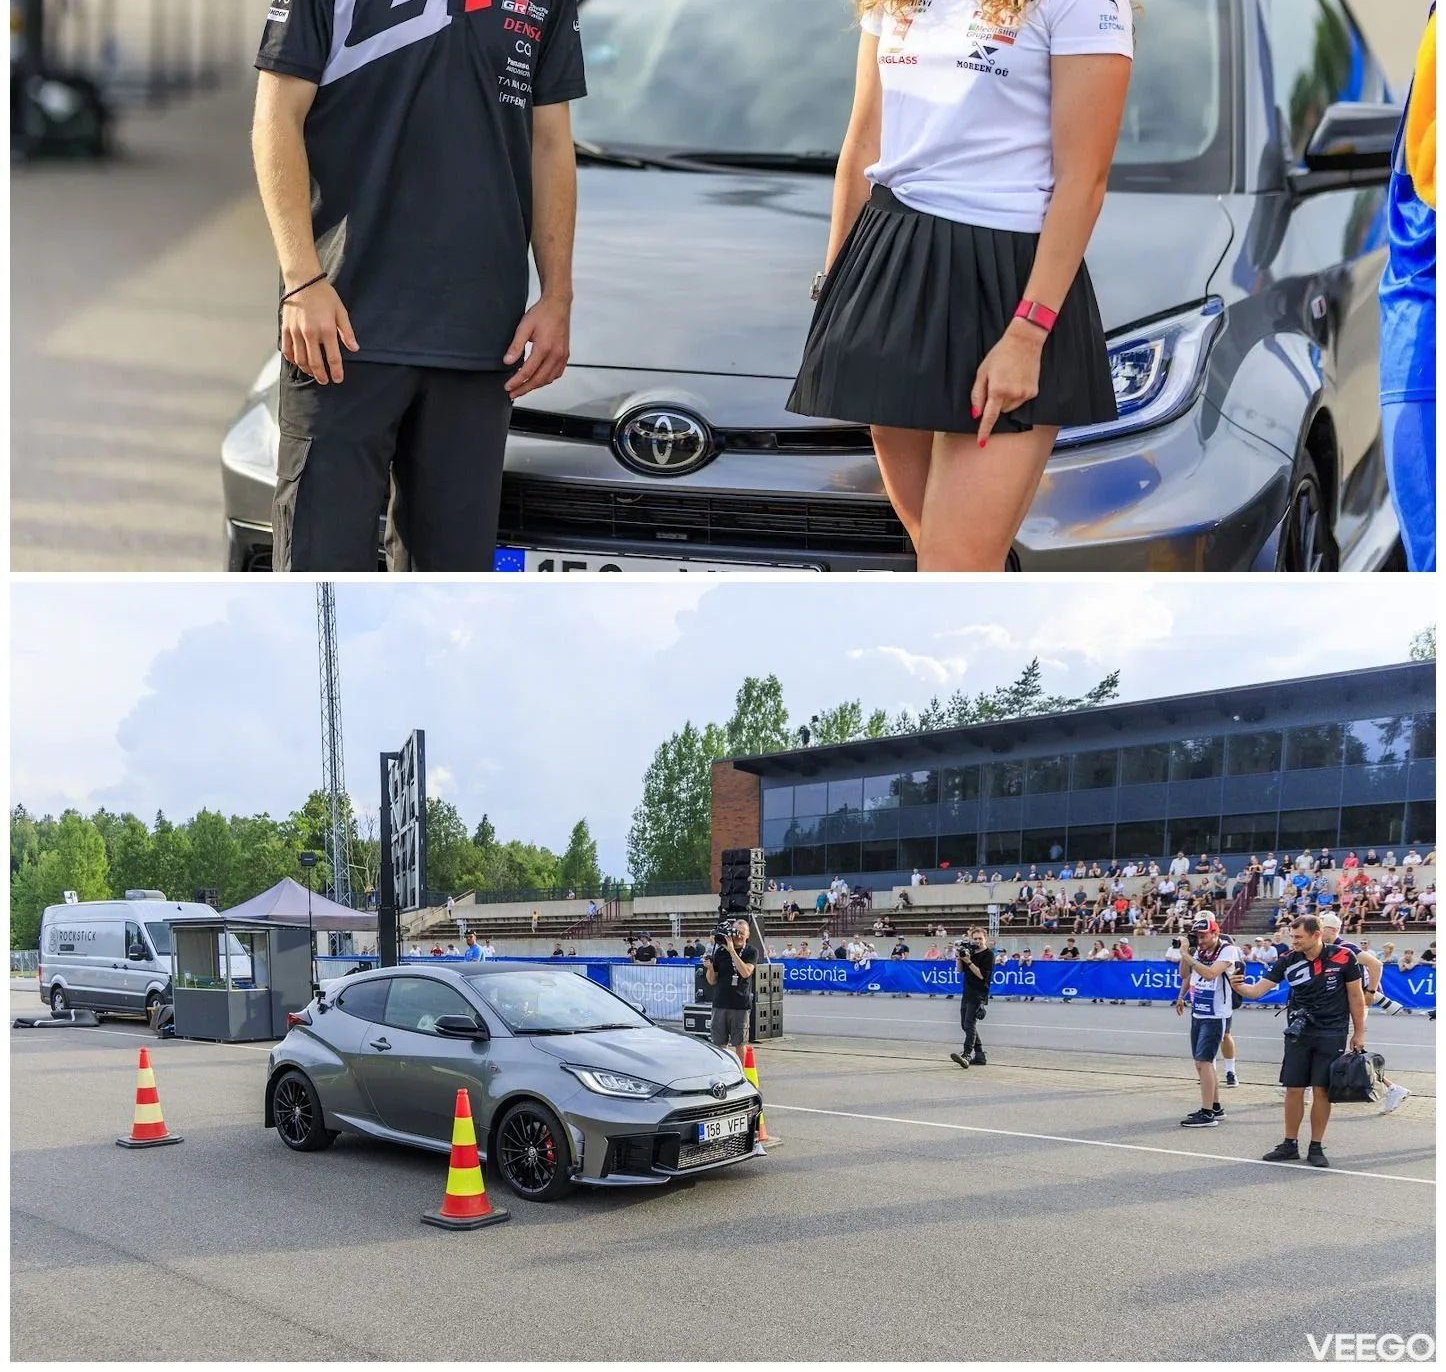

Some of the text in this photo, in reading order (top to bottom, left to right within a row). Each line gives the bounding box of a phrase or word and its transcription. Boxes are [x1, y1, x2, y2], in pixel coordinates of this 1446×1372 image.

[503, 0, 527, 15] GR
[1100, 14, 1118, 22] TEAM
[956, 60, 993, 73] MOREEN
[60, 930, 97, 942] ROCKSTICK
[790, 965, 848, 982] estonia
[922, 966, 960, 984] visit
[1131, 969, 1181, 988] visit
[706, 1116, 746, 1138] 158 VFF
